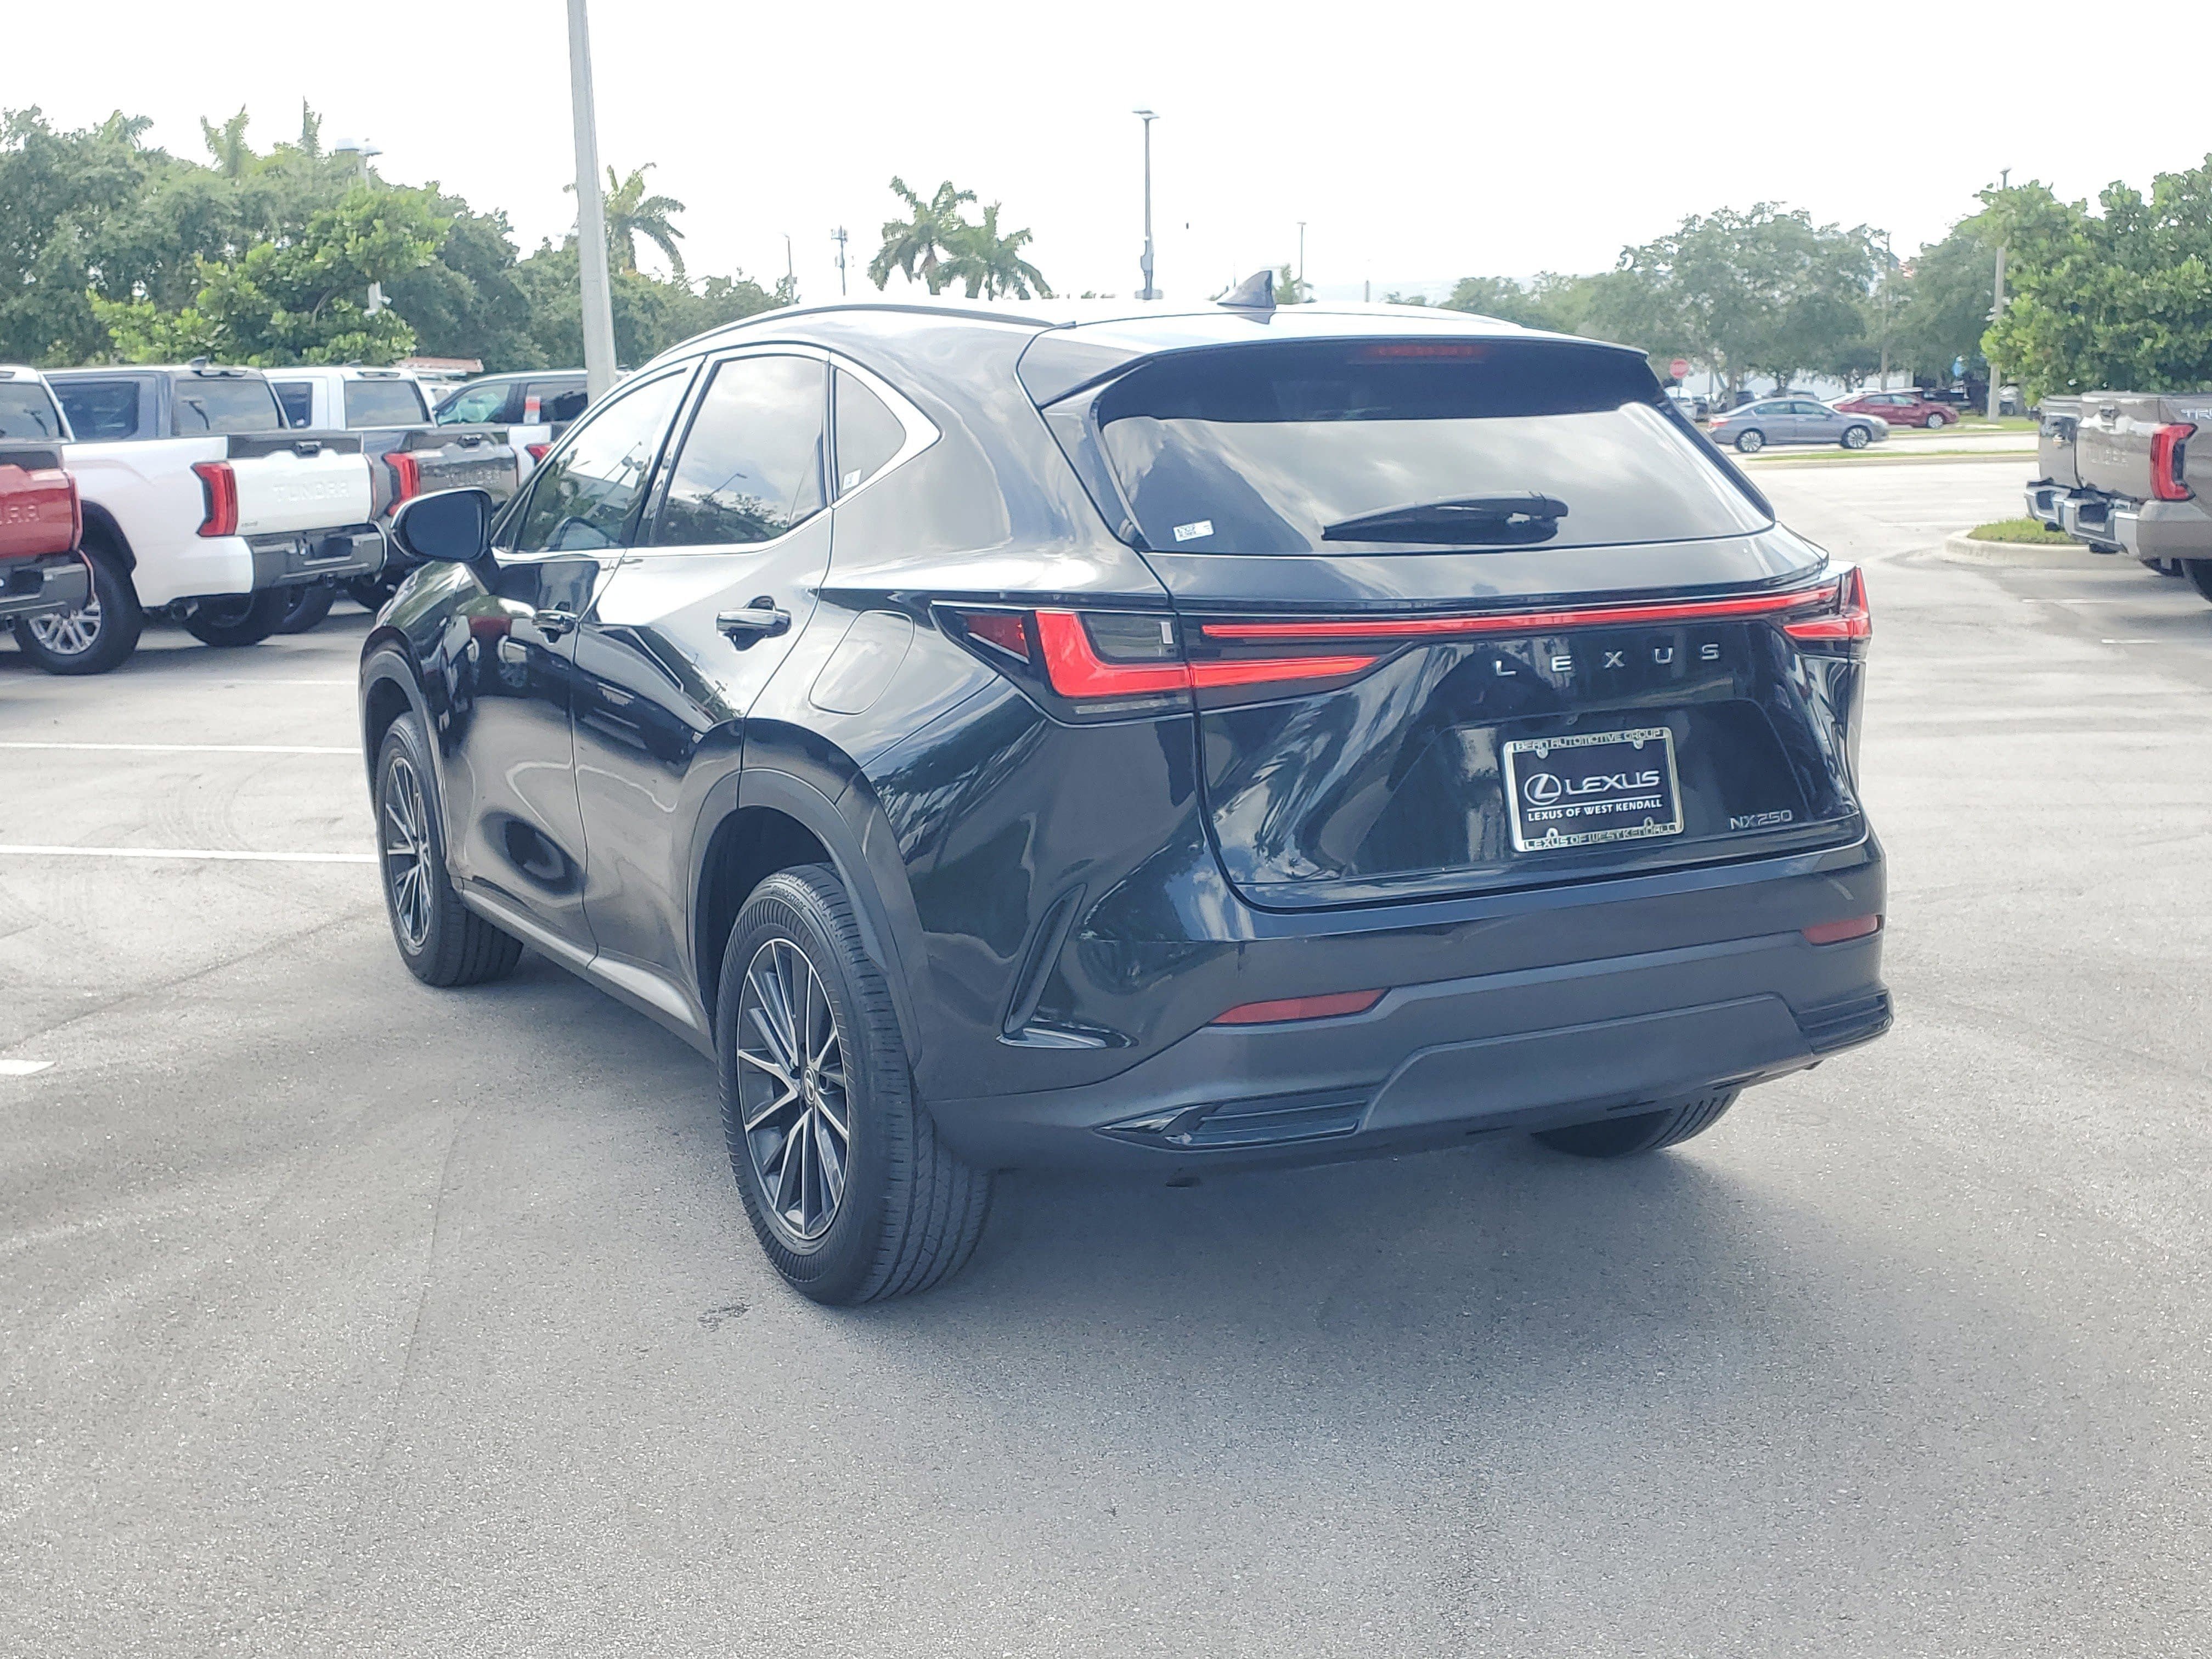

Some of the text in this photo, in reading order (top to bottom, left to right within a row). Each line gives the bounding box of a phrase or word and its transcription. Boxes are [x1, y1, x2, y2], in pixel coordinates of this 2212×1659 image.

[1495, 643, 1719, 677] LEXUS
[1551, 733, 1623, 748] AUTOMOTIVE
[1624, 729, 1661, 741] GROUP
[1565, 770, 1660, 795] LEXUS
[1528, 799, 1663, 822] LEXUS OF WEST KENDALL
[1525, 824, 1675, 850] LEXUS OF WEST KENDALL
